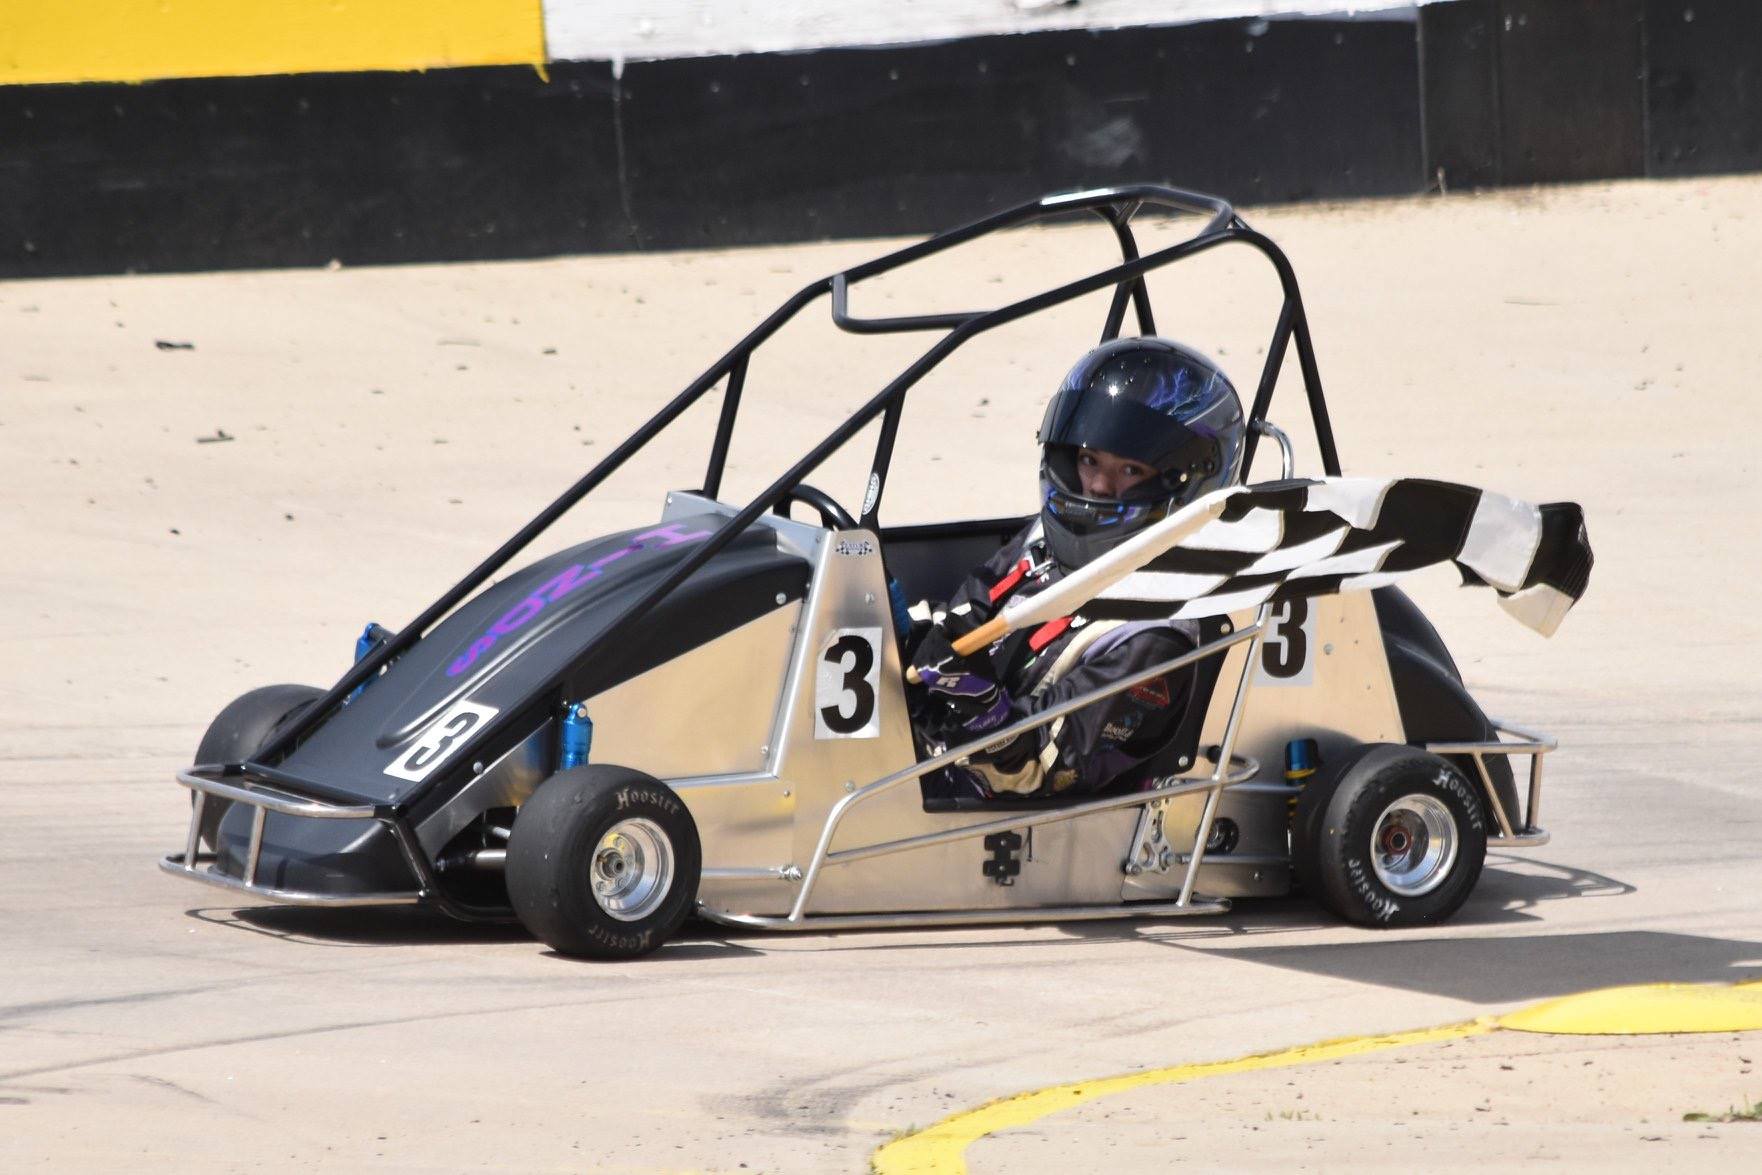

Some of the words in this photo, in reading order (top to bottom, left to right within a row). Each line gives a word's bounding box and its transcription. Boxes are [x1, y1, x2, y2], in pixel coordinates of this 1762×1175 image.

[1261, 599, 1308, 678] 3
[821, 635, 875, 734] 3
[403, 711, 480, 772] 3
[615, 785, 680, 815] Hoosier
[1433, 767, 1483, 830] Hoosier
[1347, 857, 1400, 921] Hoosier
[588, 924, 653, 950] Hoosier
